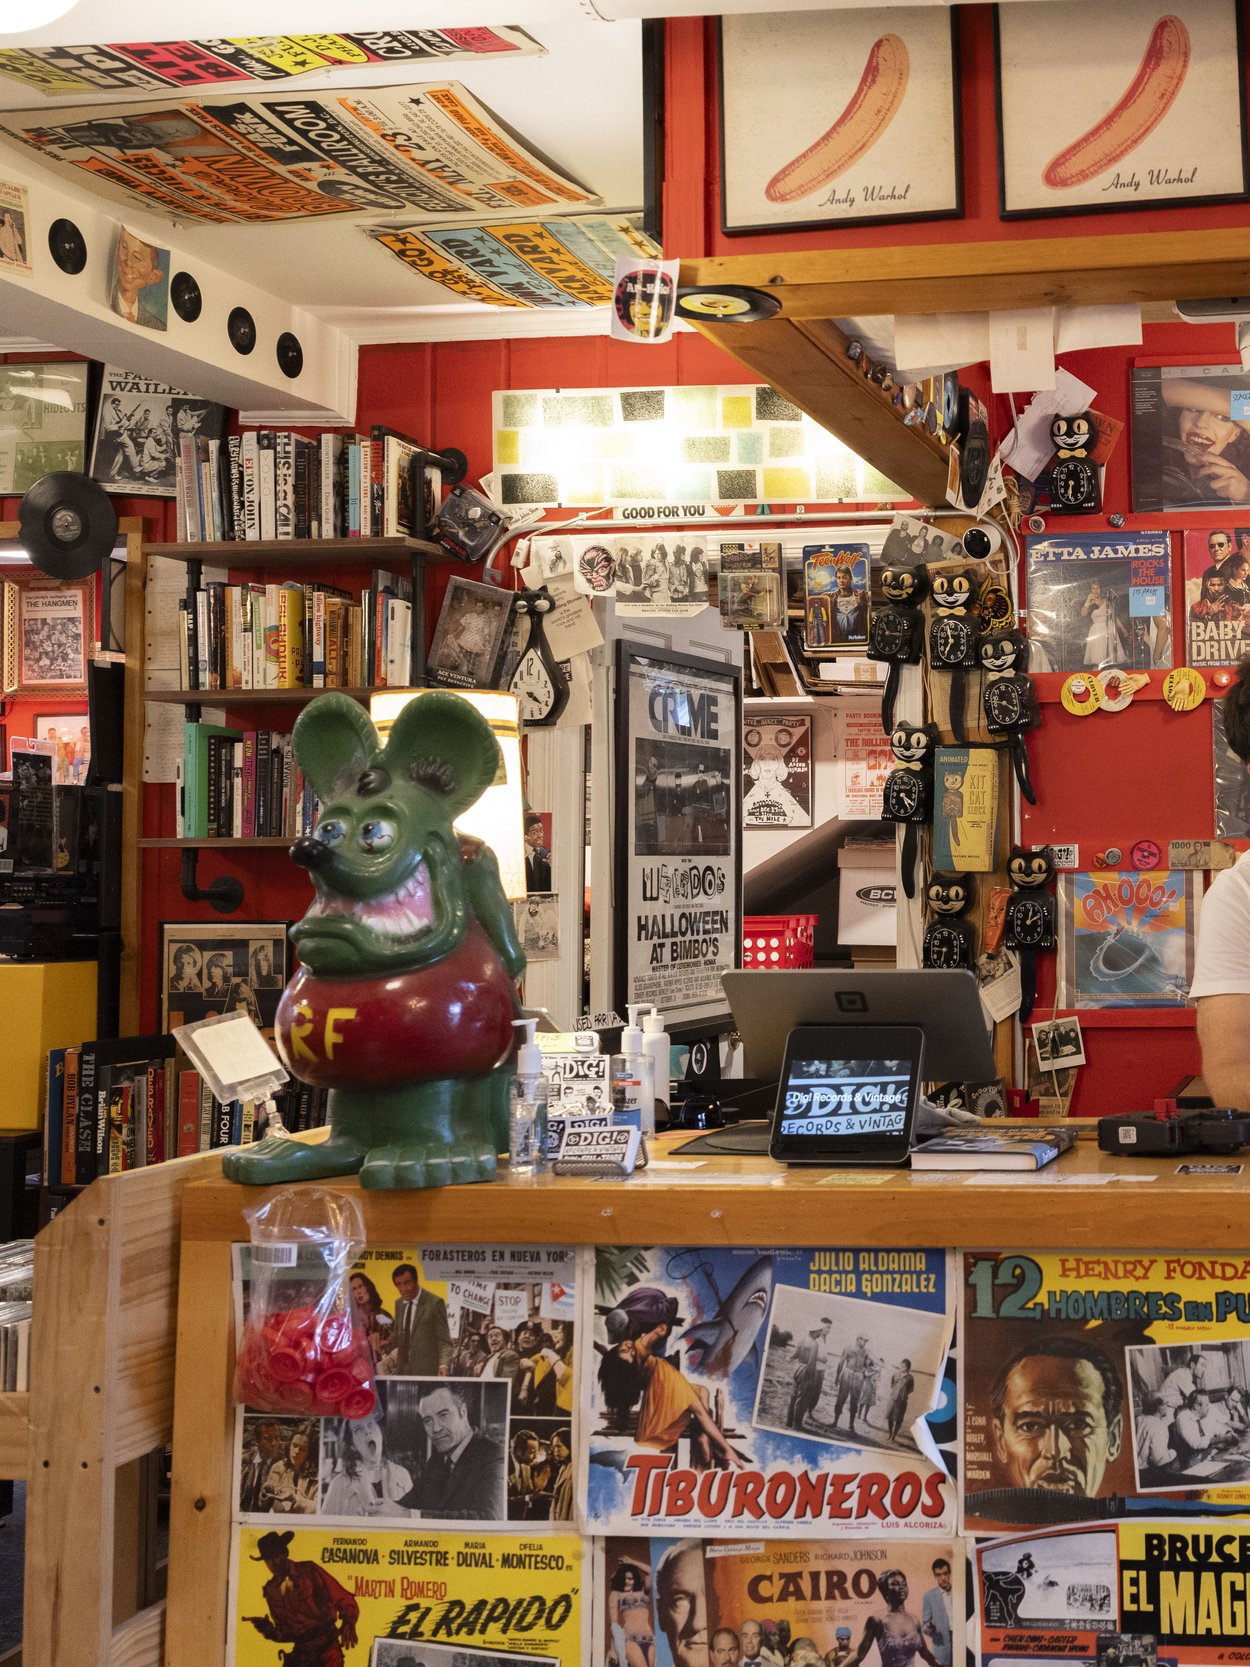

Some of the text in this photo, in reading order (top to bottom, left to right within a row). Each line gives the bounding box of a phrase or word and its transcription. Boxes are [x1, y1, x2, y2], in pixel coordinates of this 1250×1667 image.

[233, 112, 301, 150] FUNK
[273, 104, 386, 172] BALLROOM
[376, 131, 472, 184] MAY 23
[1102, 168, 1197, 191] Andy Warhol
[819, 185, 910, 207] Andy Warhol
[441, 238, 506, 278] YARD
[43, 402, 86, 414] HIDEOUTS
[244, 458, 255, 531] ELTON JOHN
[622, 504, 706, 519] GOOD FOR YOU
[1030, 543, 1165, 561] ETTA JAMES
[1131, 559, 1165, 569] ROCKS
[1138, 567, 1155, 576] THE
[1131, 576, 1165, 586] HOUSE
[25, 599, 79, 608] THE HANGMEN
[314, 593, 323, 647] blues highway
[1191, 621, 1246, 641] BABY
[845, 738, 860, 747] THE
[970, 775, 986, 790] KIT
[969, 791, 986, 805] CAT
[637, 910, 729, 942] HALLOWEEN
[650, 937, 719, 965] AT BIMBO'S
[573, 1018, 592, 1031] USED
[67, 1073, 76, 1125] BOB DYLAN
[79, 1053, 95, 1152] THE CLASH
[793, 1092, 901, 1104] Dig! Records & Vintage
[578, 1131, 617, 1145] DIG!
[375, 1250, 404, 1262] DENNIS
[422, 1249, 542, 1263] FORASTEROS EN NUEVA
[809, 1251, 926, 1272] JULIO ALDAMA
[1058, 1258, 1159, 1282] HENRY
[809, 1272, 936, 1297] DACIA GONZALEZ
[967, 1255, 1044, 1320] 12
[1047, 1291, 1182, 1321] HOMBRES
[463, 1286, 491, 1306] CHANGE
[497, 1295, 522, 1307] STOP
[626, 1453, 947, 1520] TIBURONEROS
[881, 1521, 945, 1529] LUIS ALCORIZA
[333, 1538, 543, 1551] FERNANDO ARMANDO MARIA OFELIA
[321, 1548, 564, 1571] CASANOVA SILVESTRE DUVAL MONTESCO
[773, 1549, 887, 1564] SANDERS JOHNSON
[401, 1577, 447, 1600] ROMERO
[748, 1568, 880, 1605] CAIRO
[1122, 1570, 1154, 1612] EL
[387, 1602, 428, 1638] EL
